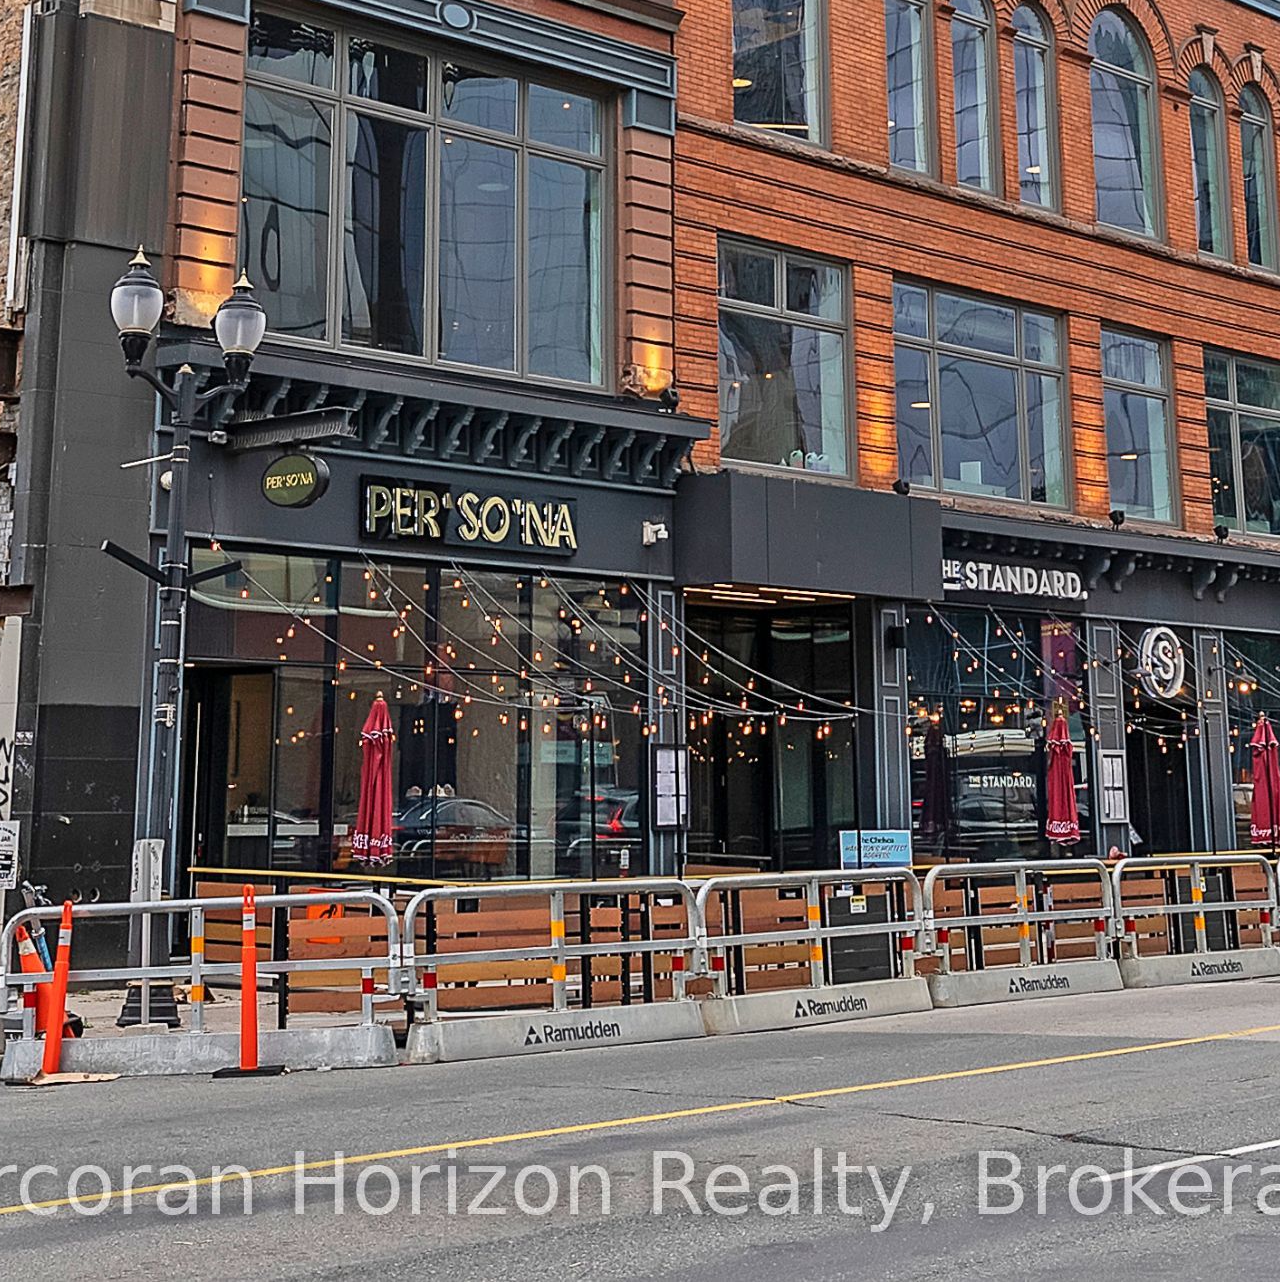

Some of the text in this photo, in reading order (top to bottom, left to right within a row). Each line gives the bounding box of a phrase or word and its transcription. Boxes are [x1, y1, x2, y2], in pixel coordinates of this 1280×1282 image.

[942, 559, 1088, 600] HE STANDARD.
[982, 775, 1036, 788] STANDARD.
[1200, 961, 1243, 976] Ramudden
[1019, 974, 1070, 993] Ramudden
[808, 995, 868, 1016] Ramudden
[543, 1020, 621, 1043] Ramudden
